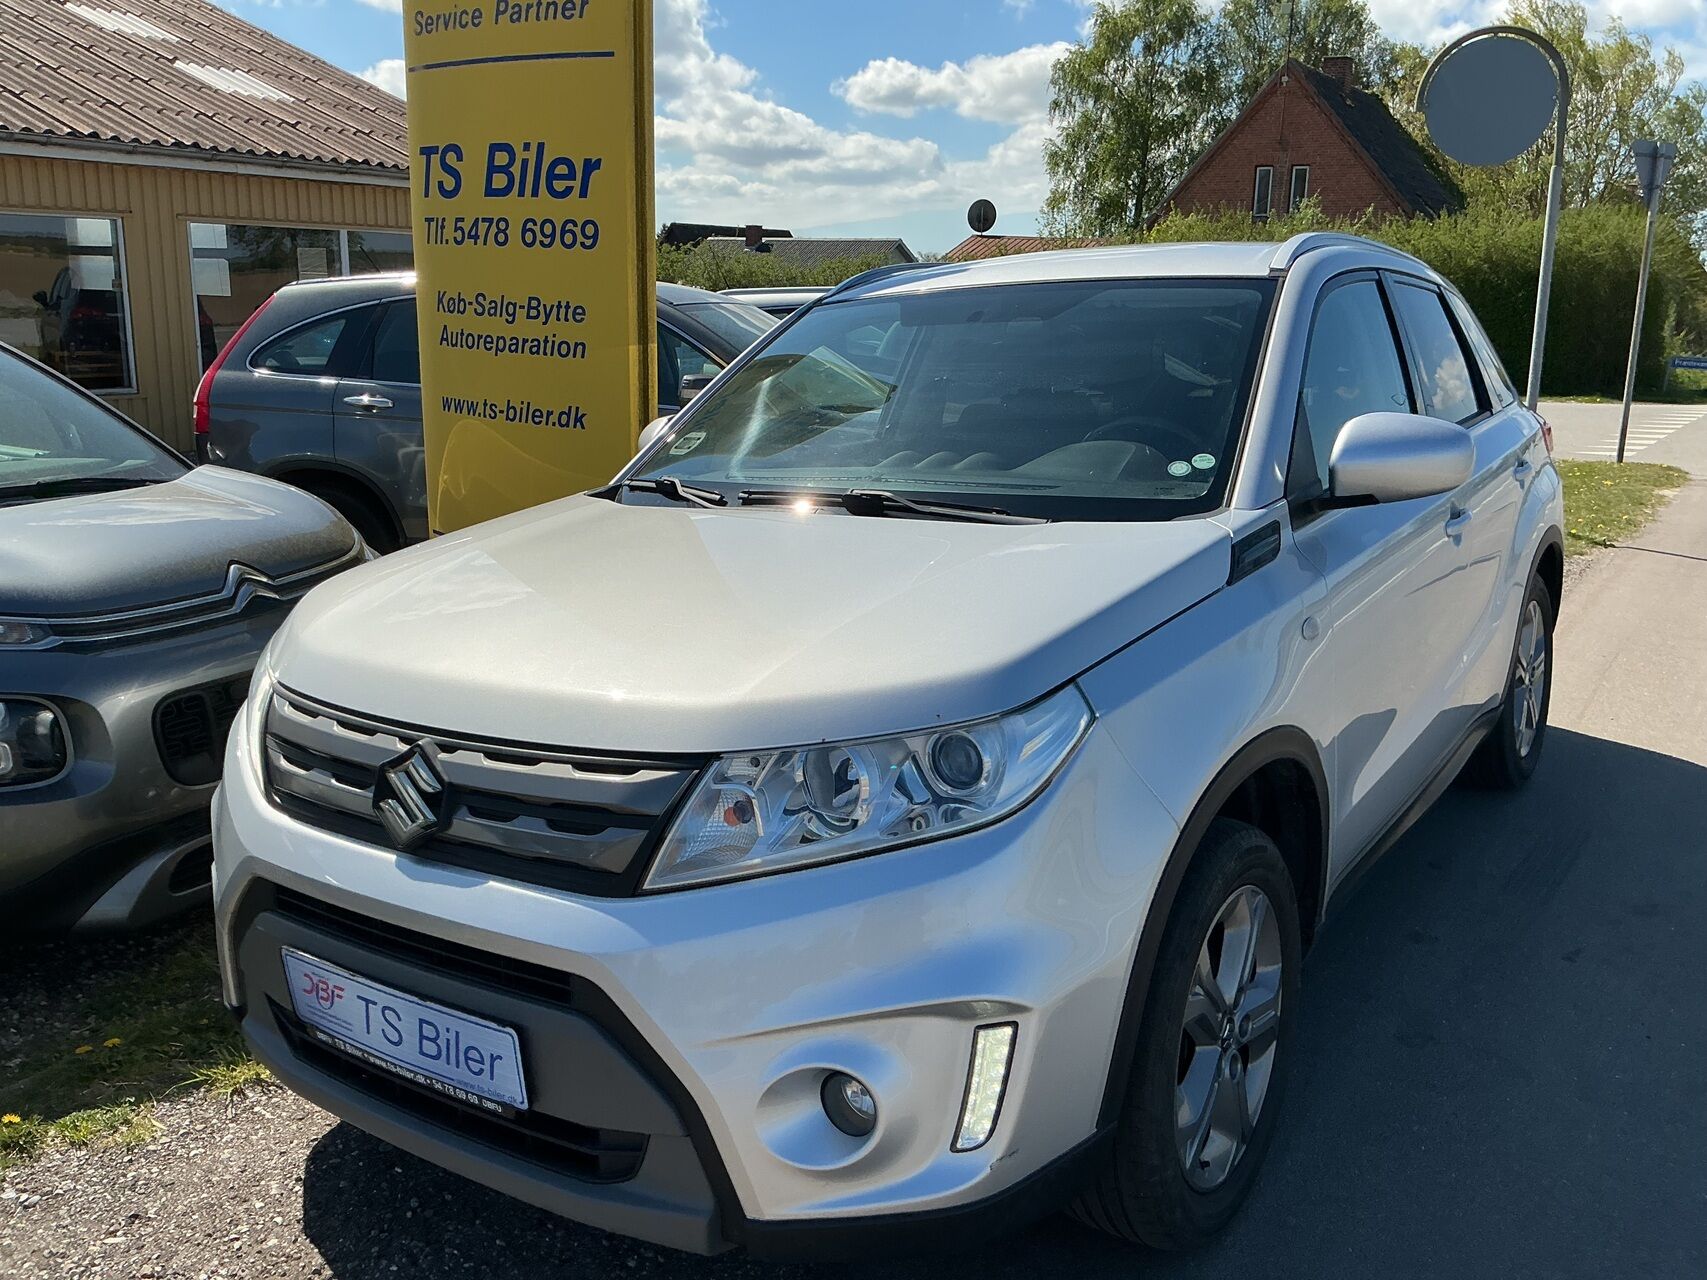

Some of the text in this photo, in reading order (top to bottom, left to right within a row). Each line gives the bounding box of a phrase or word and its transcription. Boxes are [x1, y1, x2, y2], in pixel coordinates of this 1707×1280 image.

[414, 0, 589, 36] Service Partner
[419, 141, 602, 199] TS Biler
[520, 217, 600, 250] 6969
[437, 290, 587, 325] Køb-Salg-Bytte
[439, 324, 587, 359] Autoreparation
[441, 394, 588, 430] www.ts-biler.dk
[356, 994, 503, 1081] TS Biler
